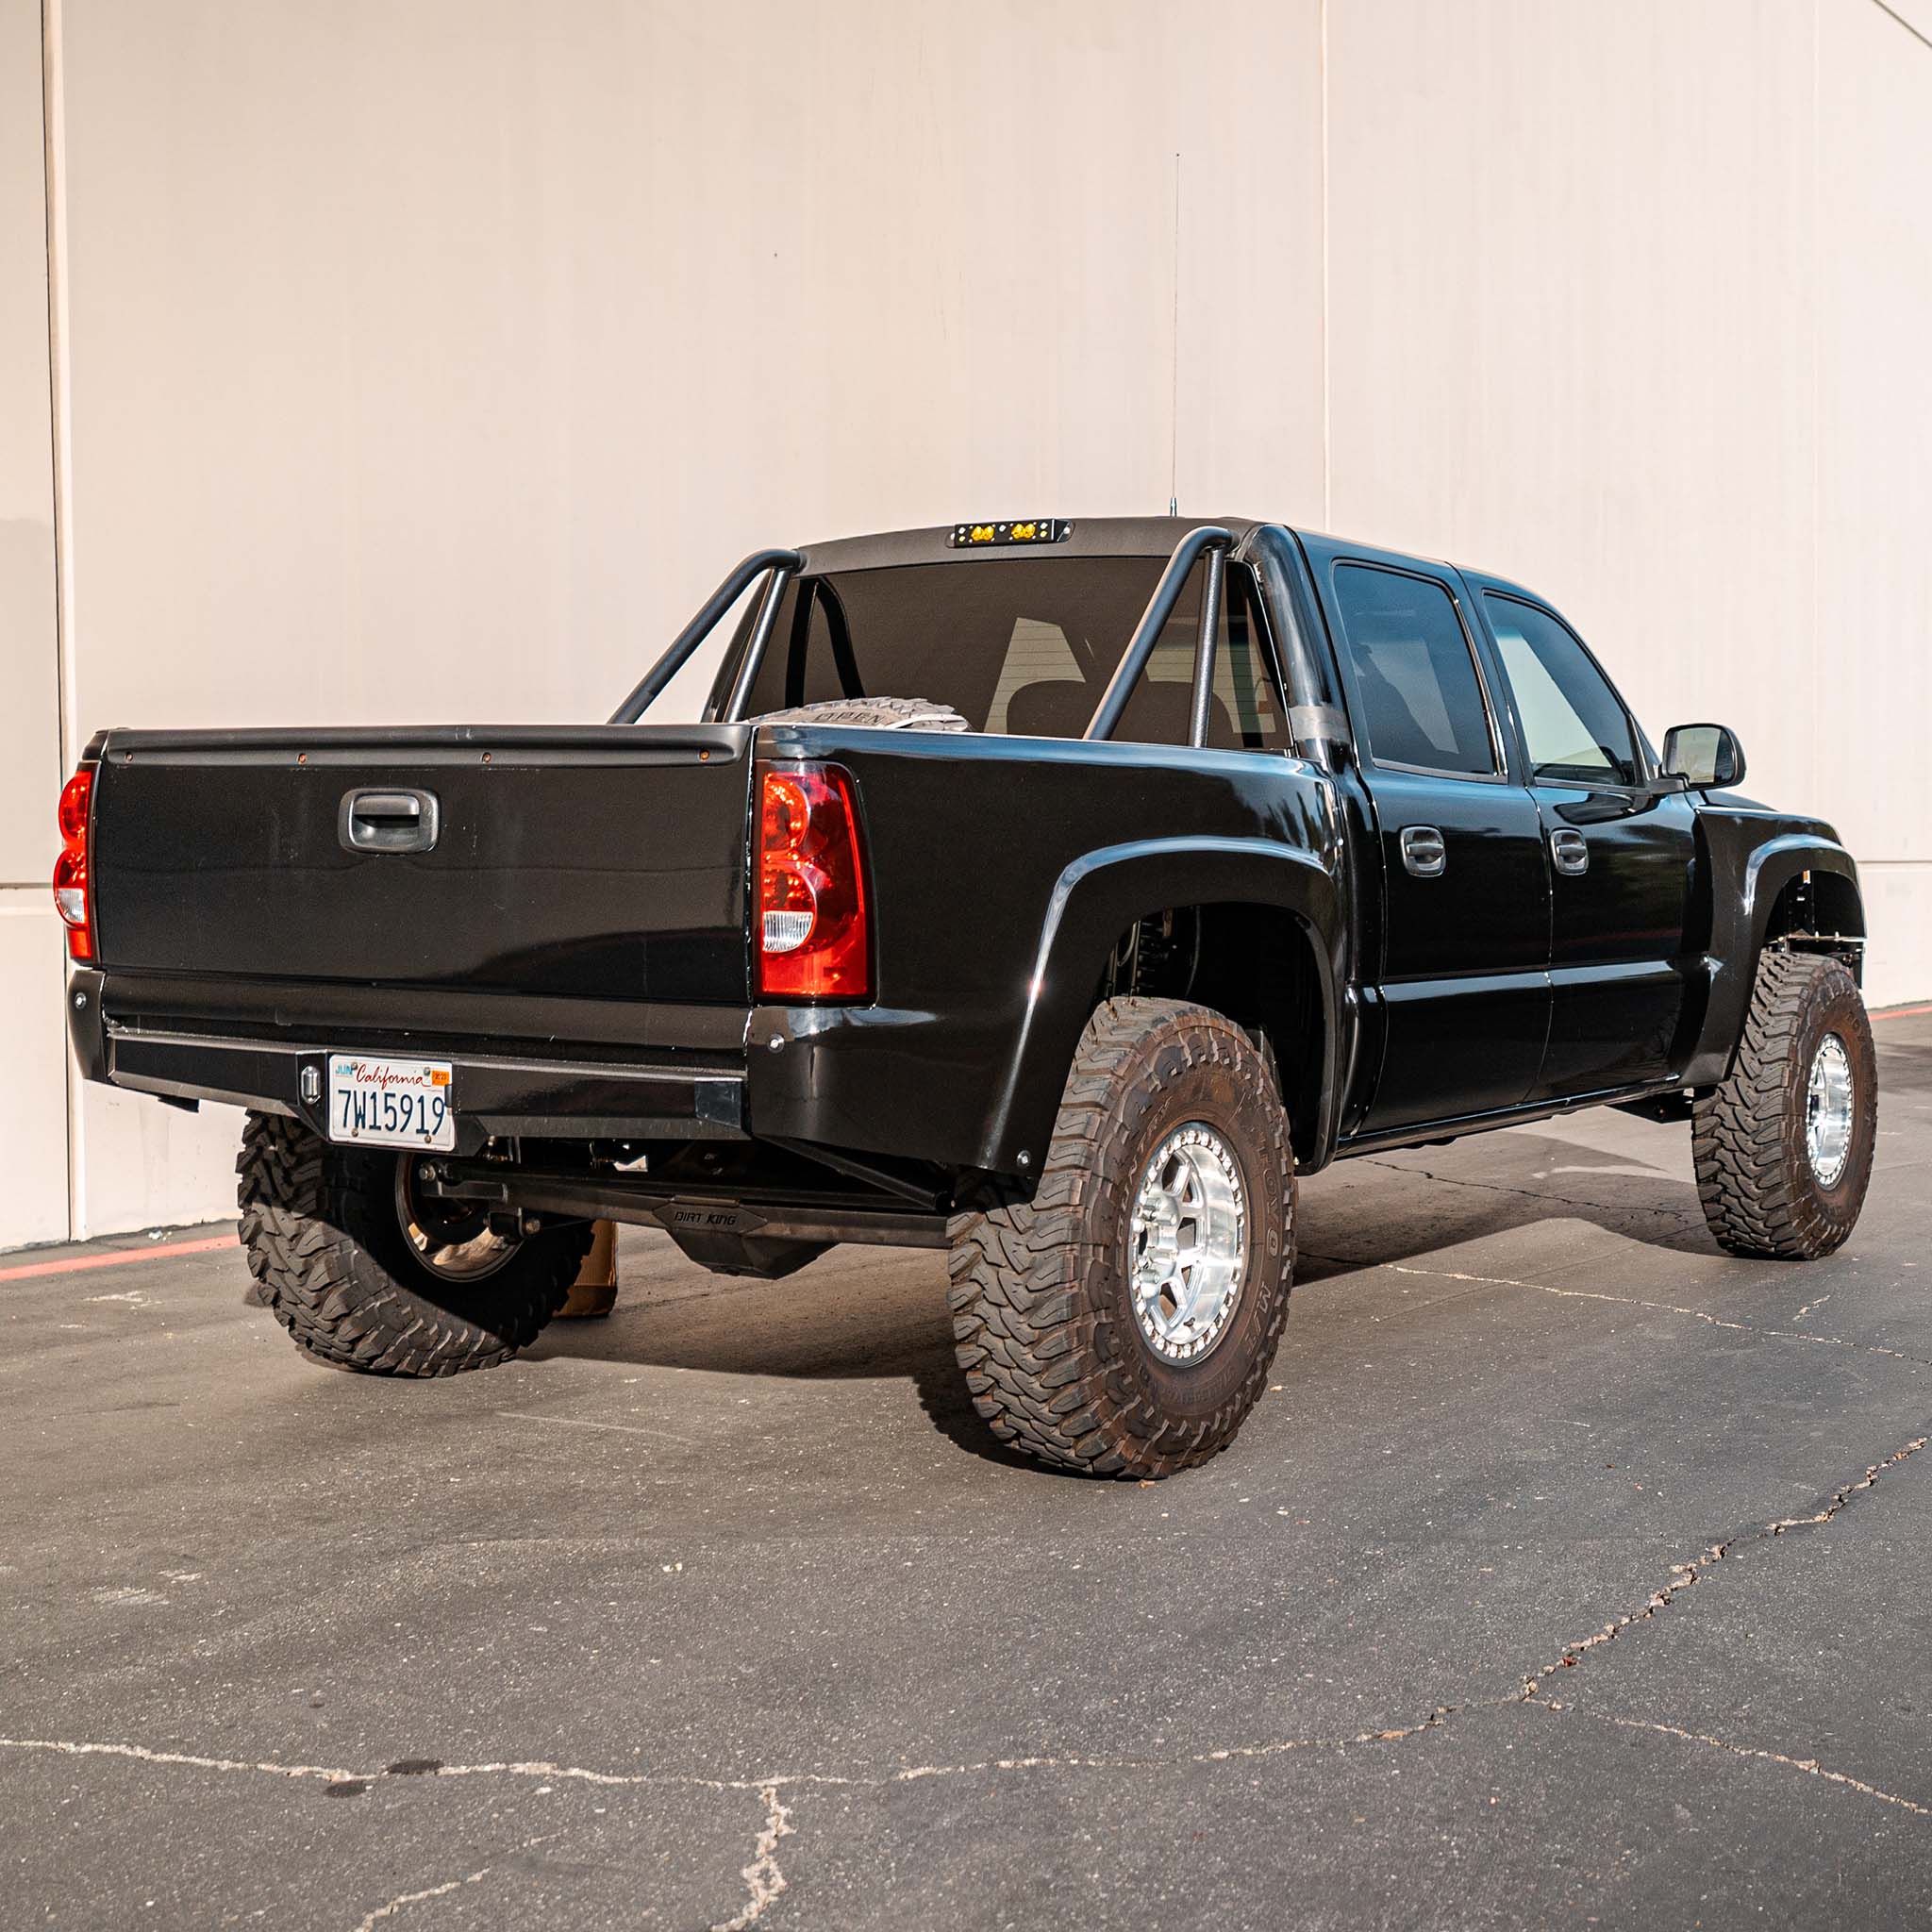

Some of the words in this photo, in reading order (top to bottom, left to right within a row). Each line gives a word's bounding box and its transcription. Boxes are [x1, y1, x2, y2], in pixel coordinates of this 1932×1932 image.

[357, 1064, 431, 1090] California
[338, 1090, 445, 1136] 7W15919
[1258, 1136, 1278, 1257] TOYO
[675, 1211, 702, 1224] DIRT
[707, 1214, 737, 1225] KING
